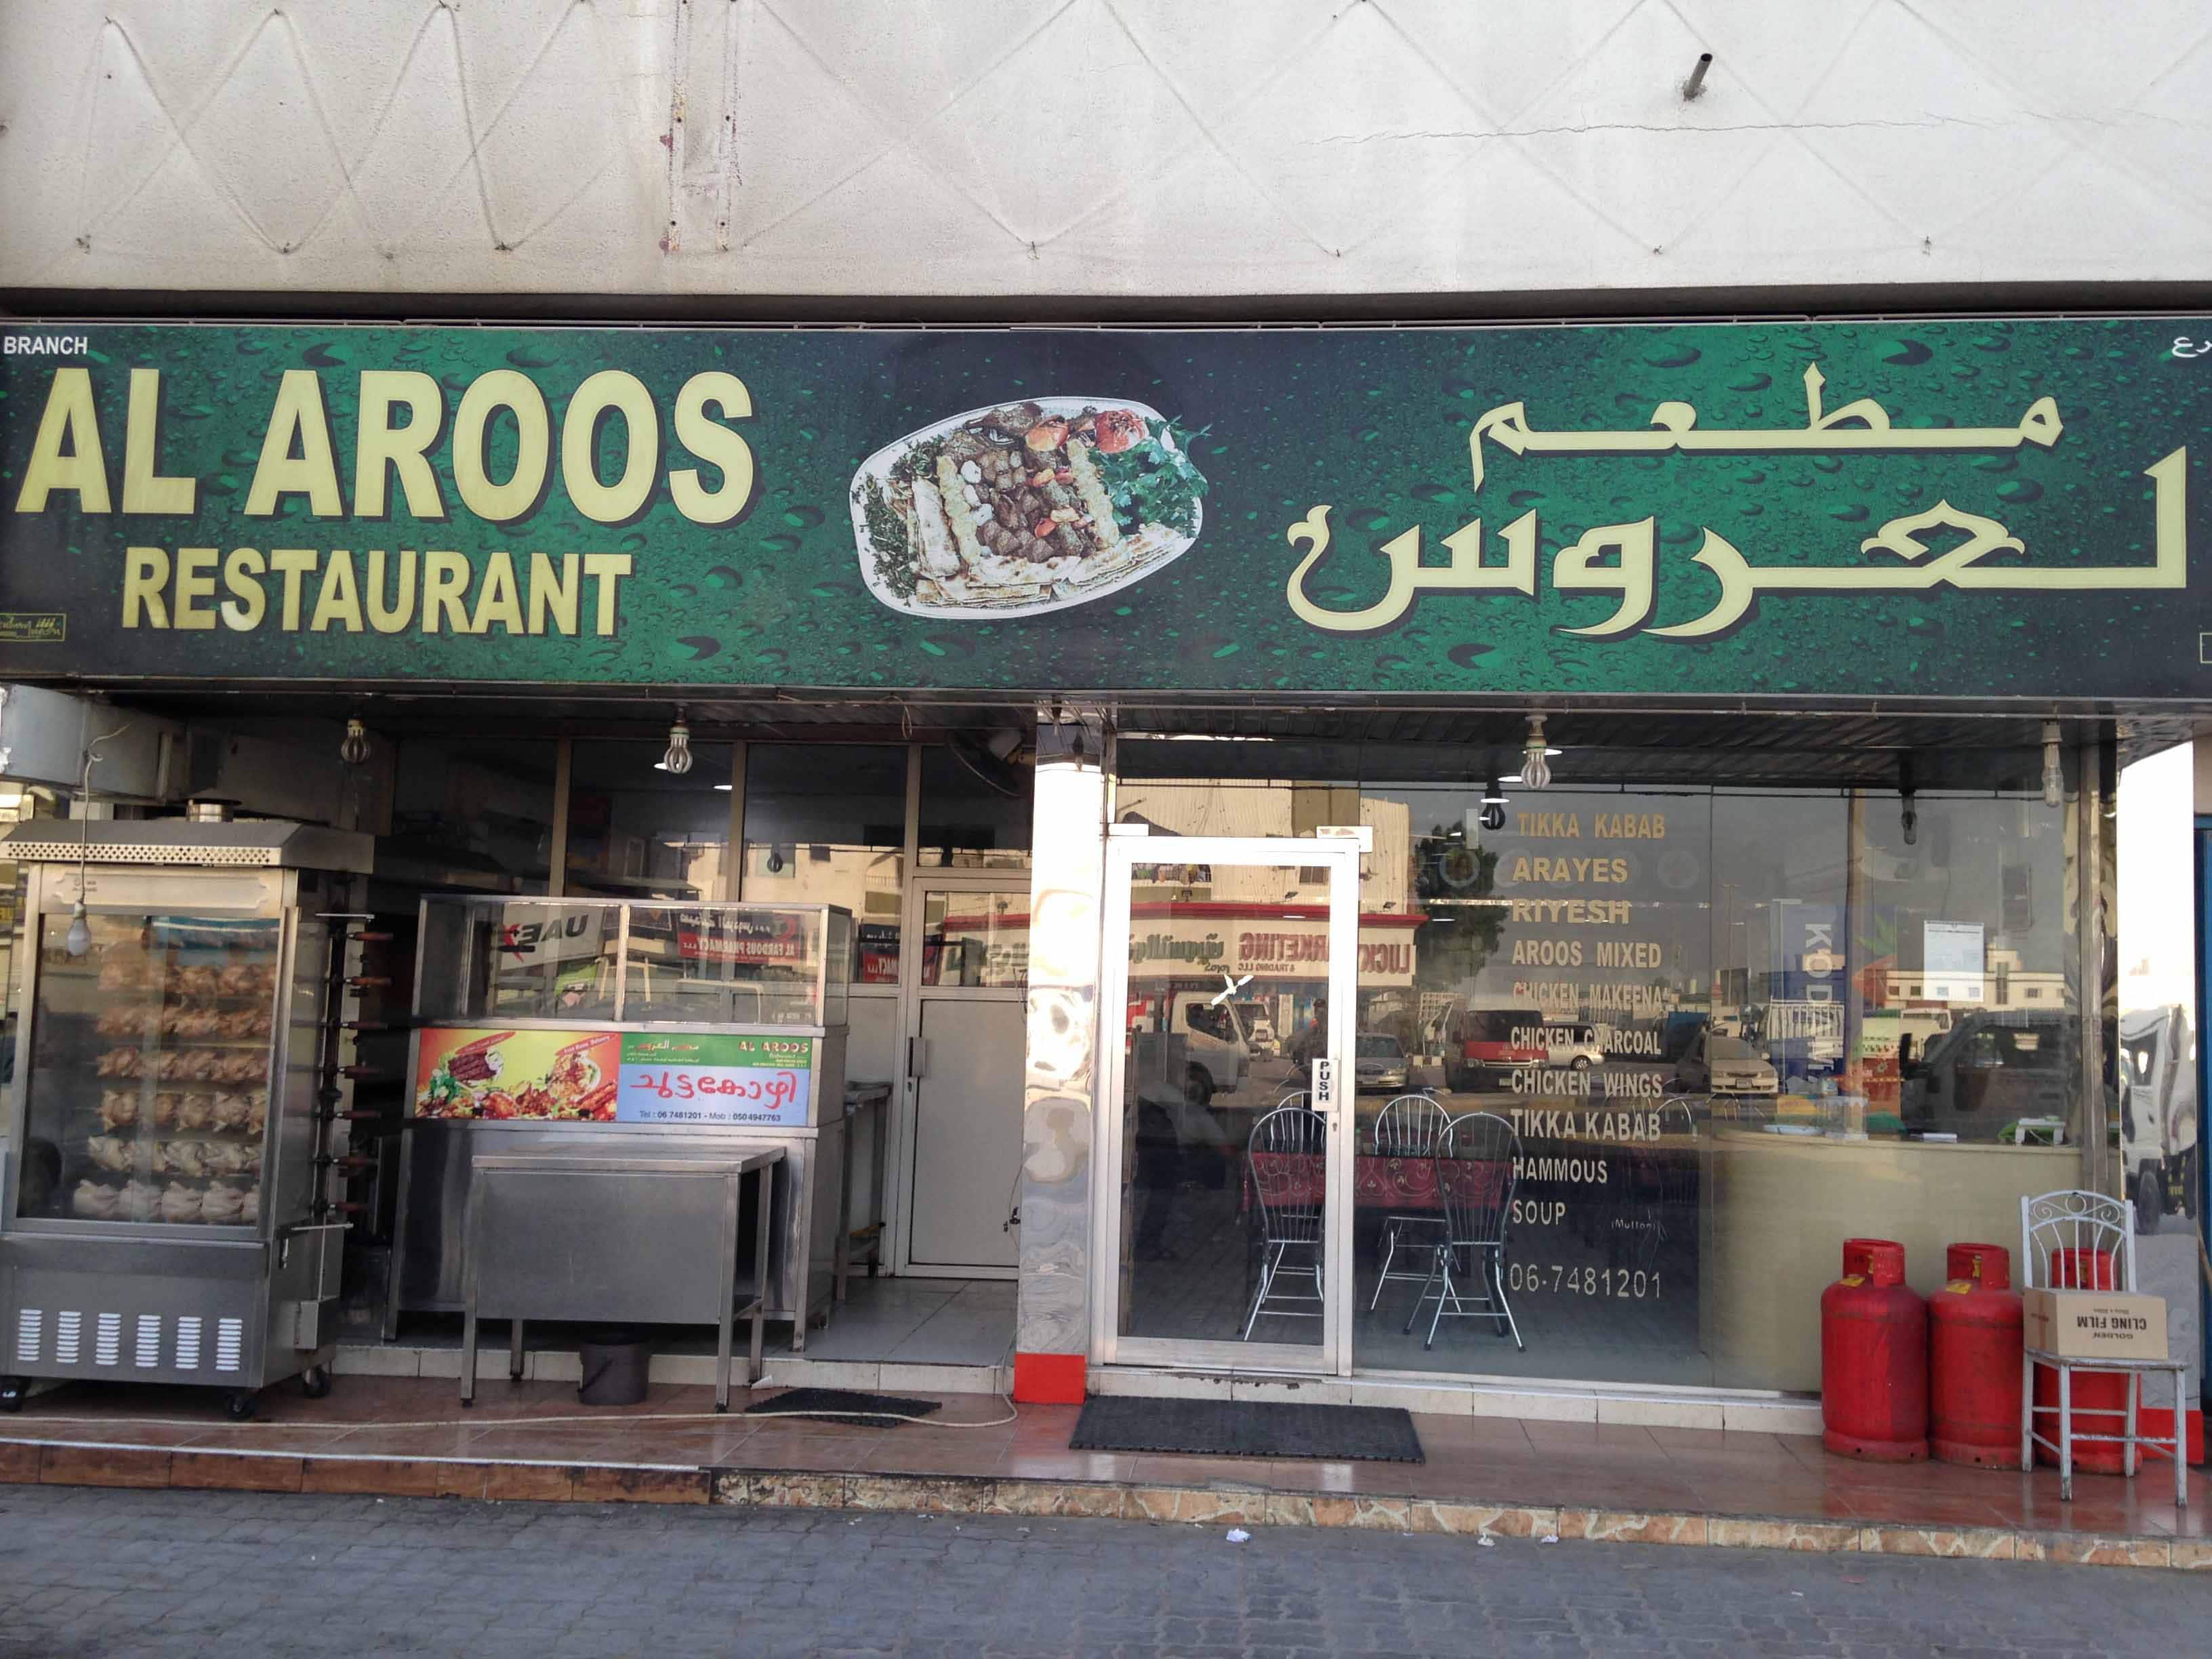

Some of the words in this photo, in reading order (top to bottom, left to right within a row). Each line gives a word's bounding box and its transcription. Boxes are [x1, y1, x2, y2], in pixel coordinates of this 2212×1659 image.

[3, 335, 88, 356] BRANCH
[1469, 361, 2064, 493] مطعم
[15, 367, 197, 514] AL
[244, 369, 754, 524] AROOS
[123, 546, 634, 637] RESTAURANT
[1517, 813, 1580, 838] TIKKA
[1594, 813, 1666, 839] KABAB
[1511, 857, 1629, 882] ARAYES
[1511, 899, 1631, 924] RIYESH
[1511, 940, 1583, 966] AROOS
[1596, 942, 1662, 968] MIXED
[1513, 981, 1579, 1010] CHICKEN
[1589, 983, 1663, 1012] MAKEENA
[739, 1040, 755, 1052] AL
[762, 1041, 808, 1053] AROOS
[1511, 1026, 1575, 1051] CHICKEN
[1584, 1029, 1662, 1055] CHARCOAL
[1318, 1061, 1330, 1101] PUSH
[1511, 1069, 1591, 1097] CHICKEN
[1603, 1073, 1663, 1098] WINGS
[657, 1111, 667, 1119] 06
[669, 1111, 701, 1120] 7481201
[1510, 1109, 1577, 1139] TIKKA
[1584, 1111, 1661, 1142] KABAB
[1512, 1158, 1608, 1184] HAMMOUS
[1512, 1201, 1566, 1226] SOUP
[1510, 1263, 1660, 1299] 06-7481201
[2076, 1315, 2108, 1329] FILM
[2112, 1317, 2147, 1331] CLING
